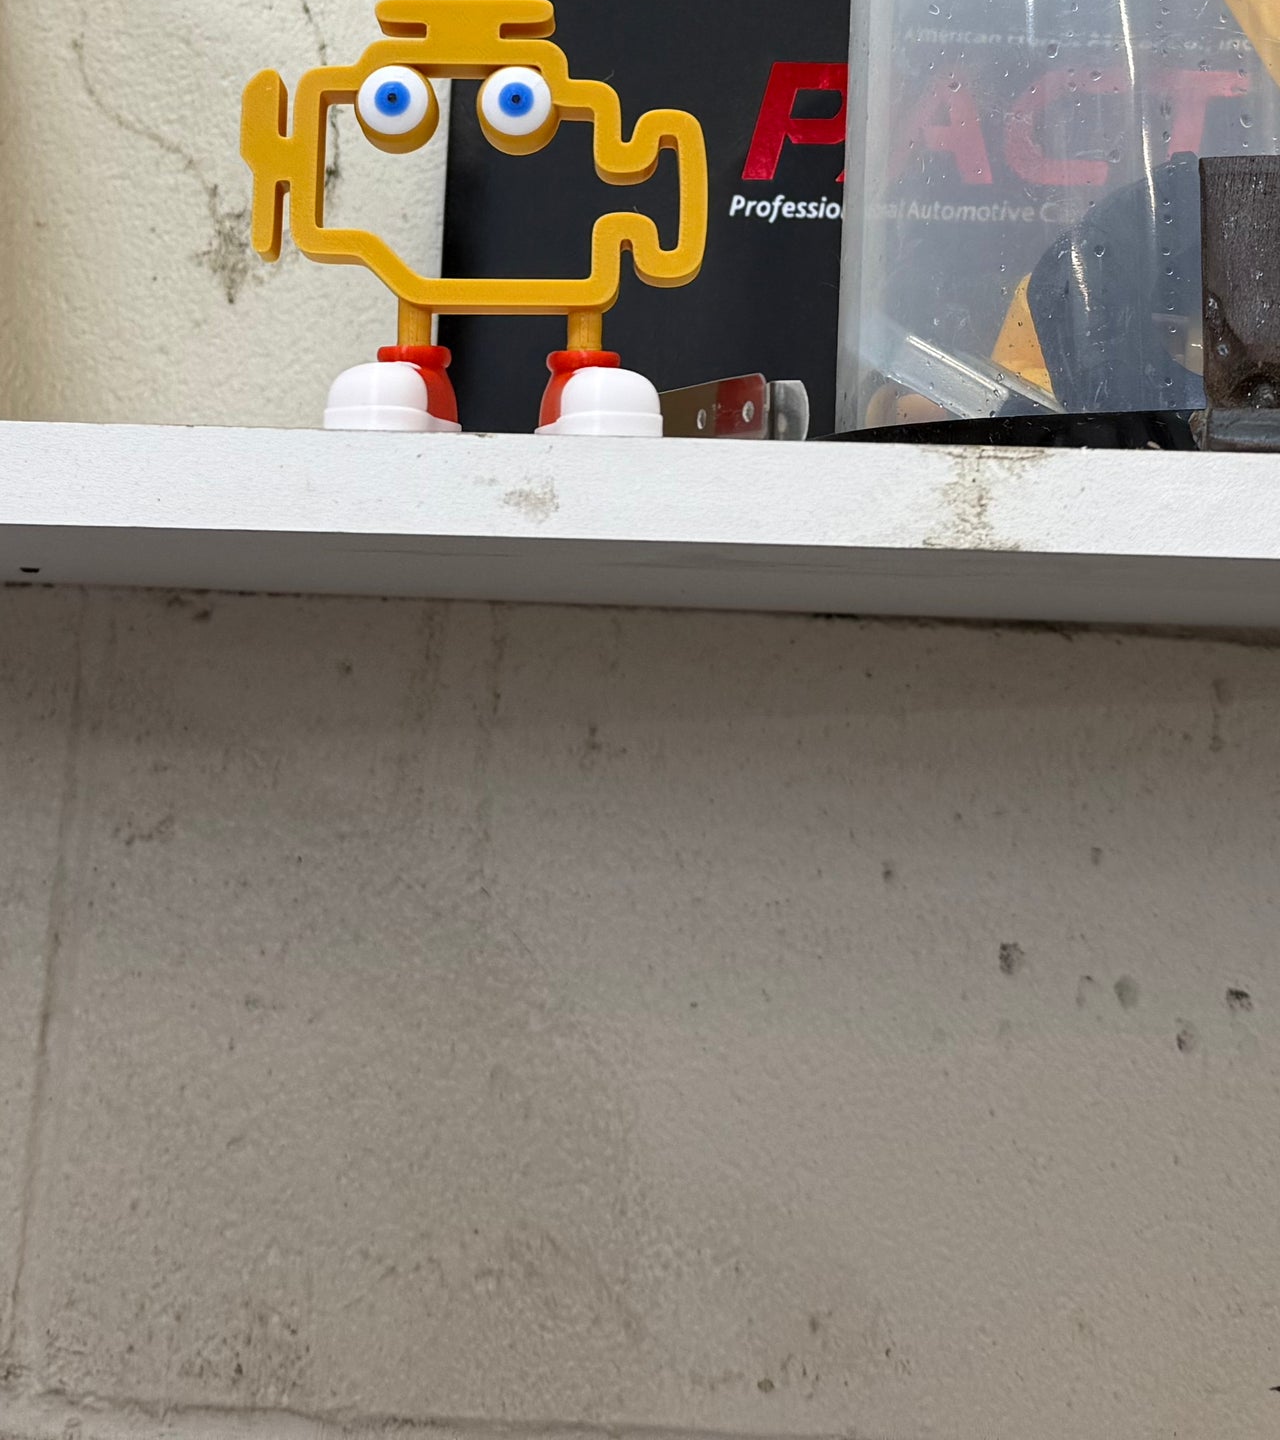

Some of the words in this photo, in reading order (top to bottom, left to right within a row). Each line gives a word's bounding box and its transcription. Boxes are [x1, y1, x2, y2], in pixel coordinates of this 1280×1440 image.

[742, 62, 1250, 186] PACT
[728, 194, 904, 224] Professioal
[907, 198, 1036, 224] Automotive
